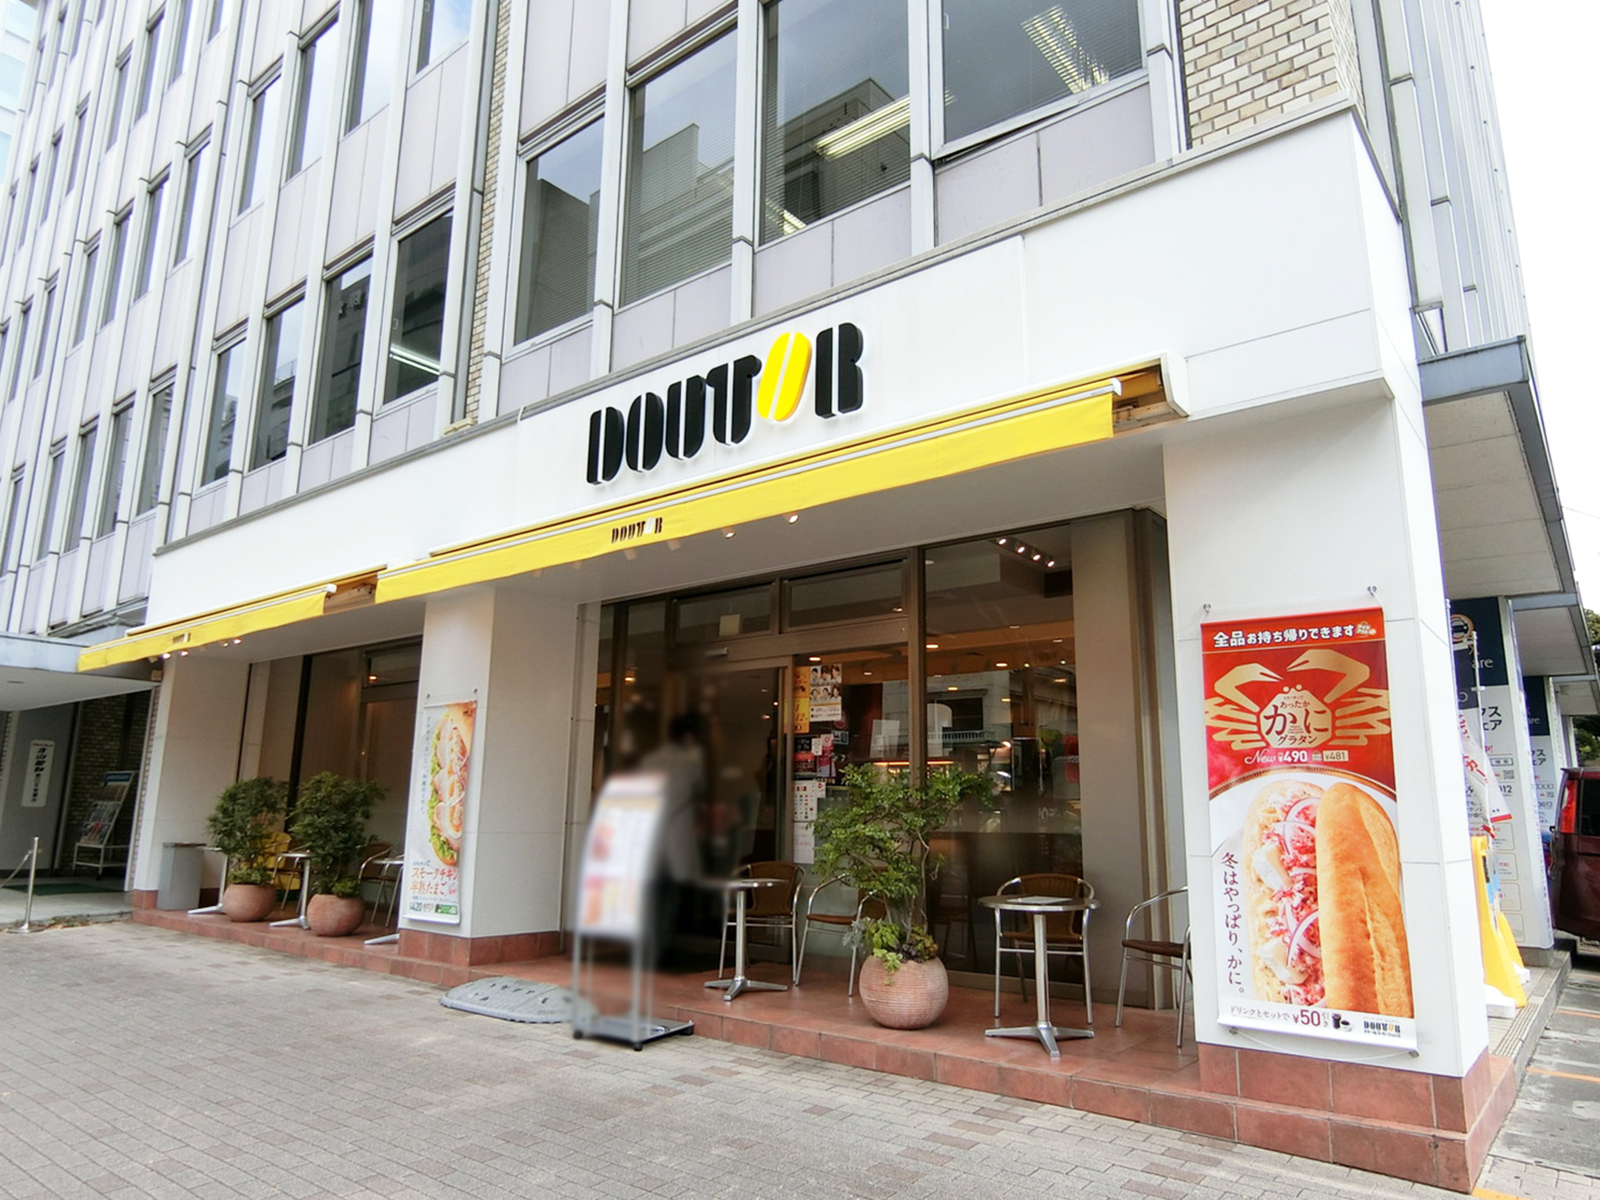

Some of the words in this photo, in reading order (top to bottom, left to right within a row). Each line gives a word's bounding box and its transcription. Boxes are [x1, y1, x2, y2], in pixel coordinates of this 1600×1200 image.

[586, 322, 863, 484] DOUTOR
[611, 517, 663, 543] DOUTOR
[1213, 625, 1354, 647] 全品お持ち帰りできます
[1263, 704, 1329, 735] かに
[1278, 734, 1318, 746] グラタン
[1244, 749, 1275, 764] New
[1278, 750, 1308, 762] ¥490
[1325, 751, 1345, 760] ¥481
[1221, 852, 1244, 993] 冬はやっぱり、かに。
[1231, 1005, 1290, 1020] ドリンクとセットで
[1293, 1009, 1321, 1026] ¥50
[1364, 1020, 1401, 1033] DOUTOR
